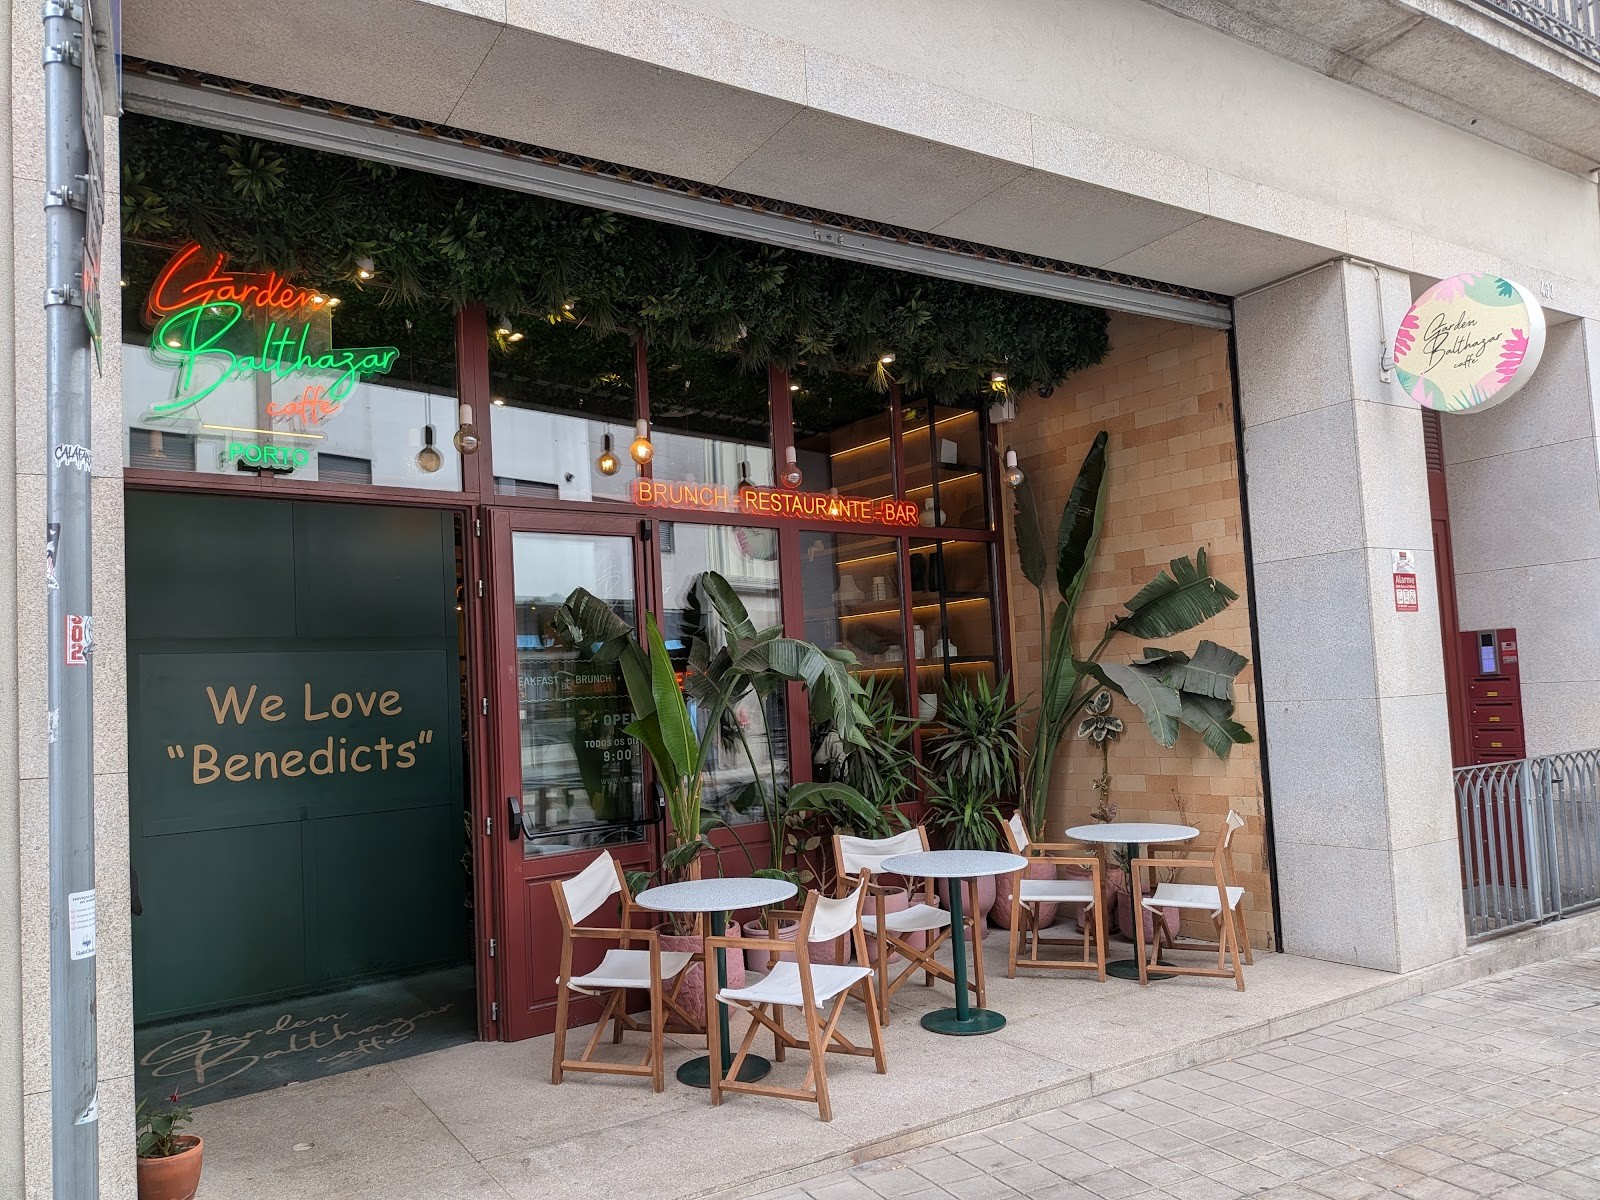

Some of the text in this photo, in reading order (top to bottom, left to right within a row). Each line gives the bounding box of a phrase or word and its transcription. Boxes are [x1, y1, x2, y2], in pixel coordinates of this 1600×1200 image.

[155, 244, 328, 311] Garden
[1423, 310, 1478, 341] Garden
[154, 302, 396, 411] Balthazar
[1420, 331, 1503, 375] Balthazar
[229, 442, 309, 466] PORTO
[639, 481, 728, 507] BRUNCH
[745, 490, 872, 519] RESTAURANTE
[885, 503, 917, 523] BAR
[1395, 575, 1415, 584] Alarme
[575, 674, 612, 684] BRUNCH
[206, 682, 402, 725] We Love
[584, 740, 611, 748] TODOS
[627, 737, 640, 746] DIA
[603, 749, 632, 762] 9:00
[141, 1014, 349, 1066] Garden
[152, 1003, 455, 1100] Balthazar
